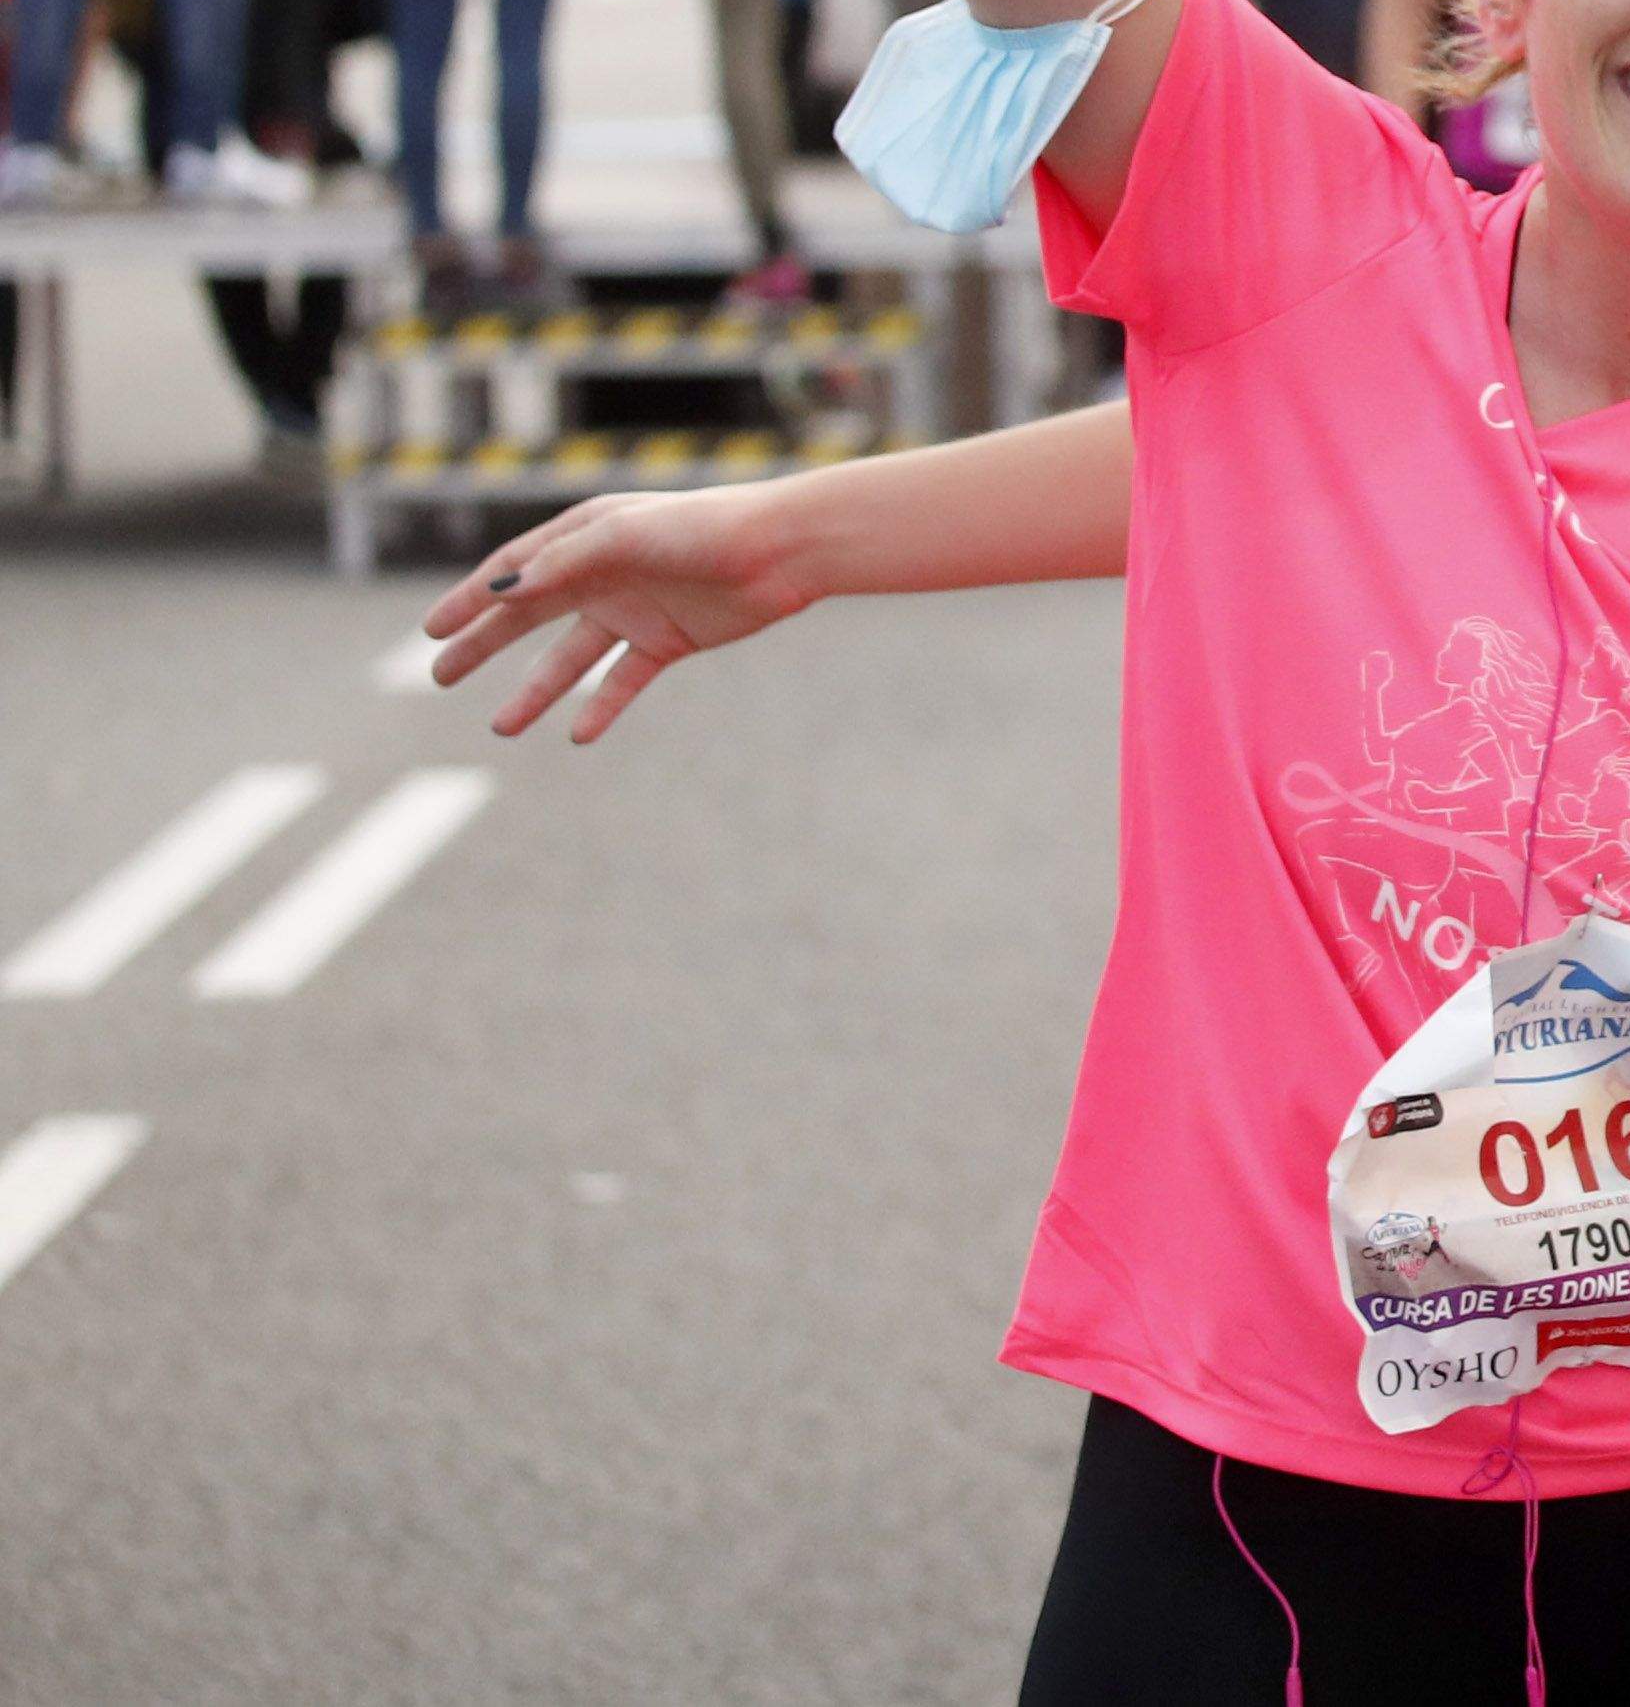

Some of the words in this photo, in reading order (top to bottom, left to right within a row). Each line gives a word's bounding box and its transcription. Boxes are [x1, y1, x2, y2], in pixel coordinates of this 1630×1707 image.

[1370, 1295, 1453, 1326] CURSA
[1459, 1290, 1498, 1316] DE
[1502, 1284, 1555, 1314] LES
[1377, 1346, 1519, 1397] OYSHO
